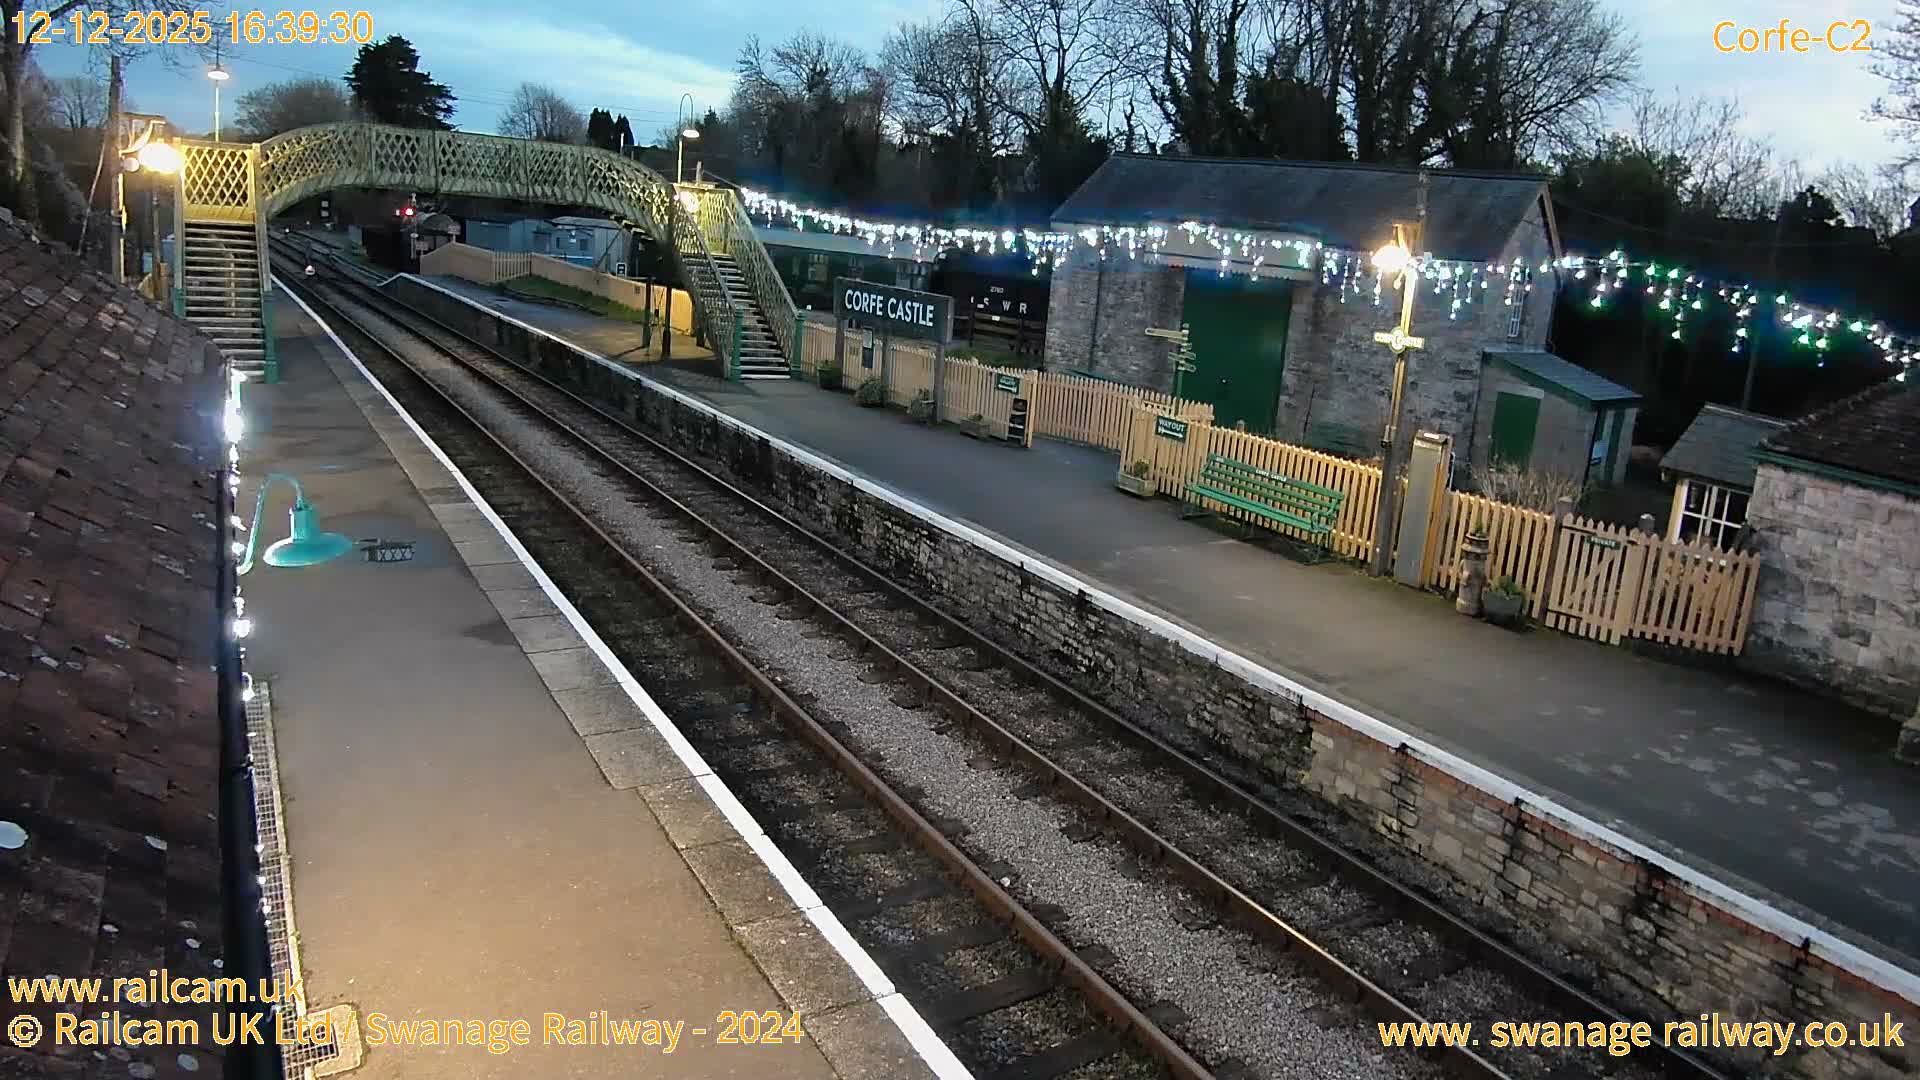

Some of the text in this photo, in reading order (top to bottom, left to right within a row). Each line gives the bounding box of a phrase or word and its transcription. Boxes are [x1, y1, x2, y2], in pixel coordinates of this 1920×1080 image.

[845, 289, 934, 327] CORFE CASTLE
[1158, 418, 1185, 432] WAY OUT
